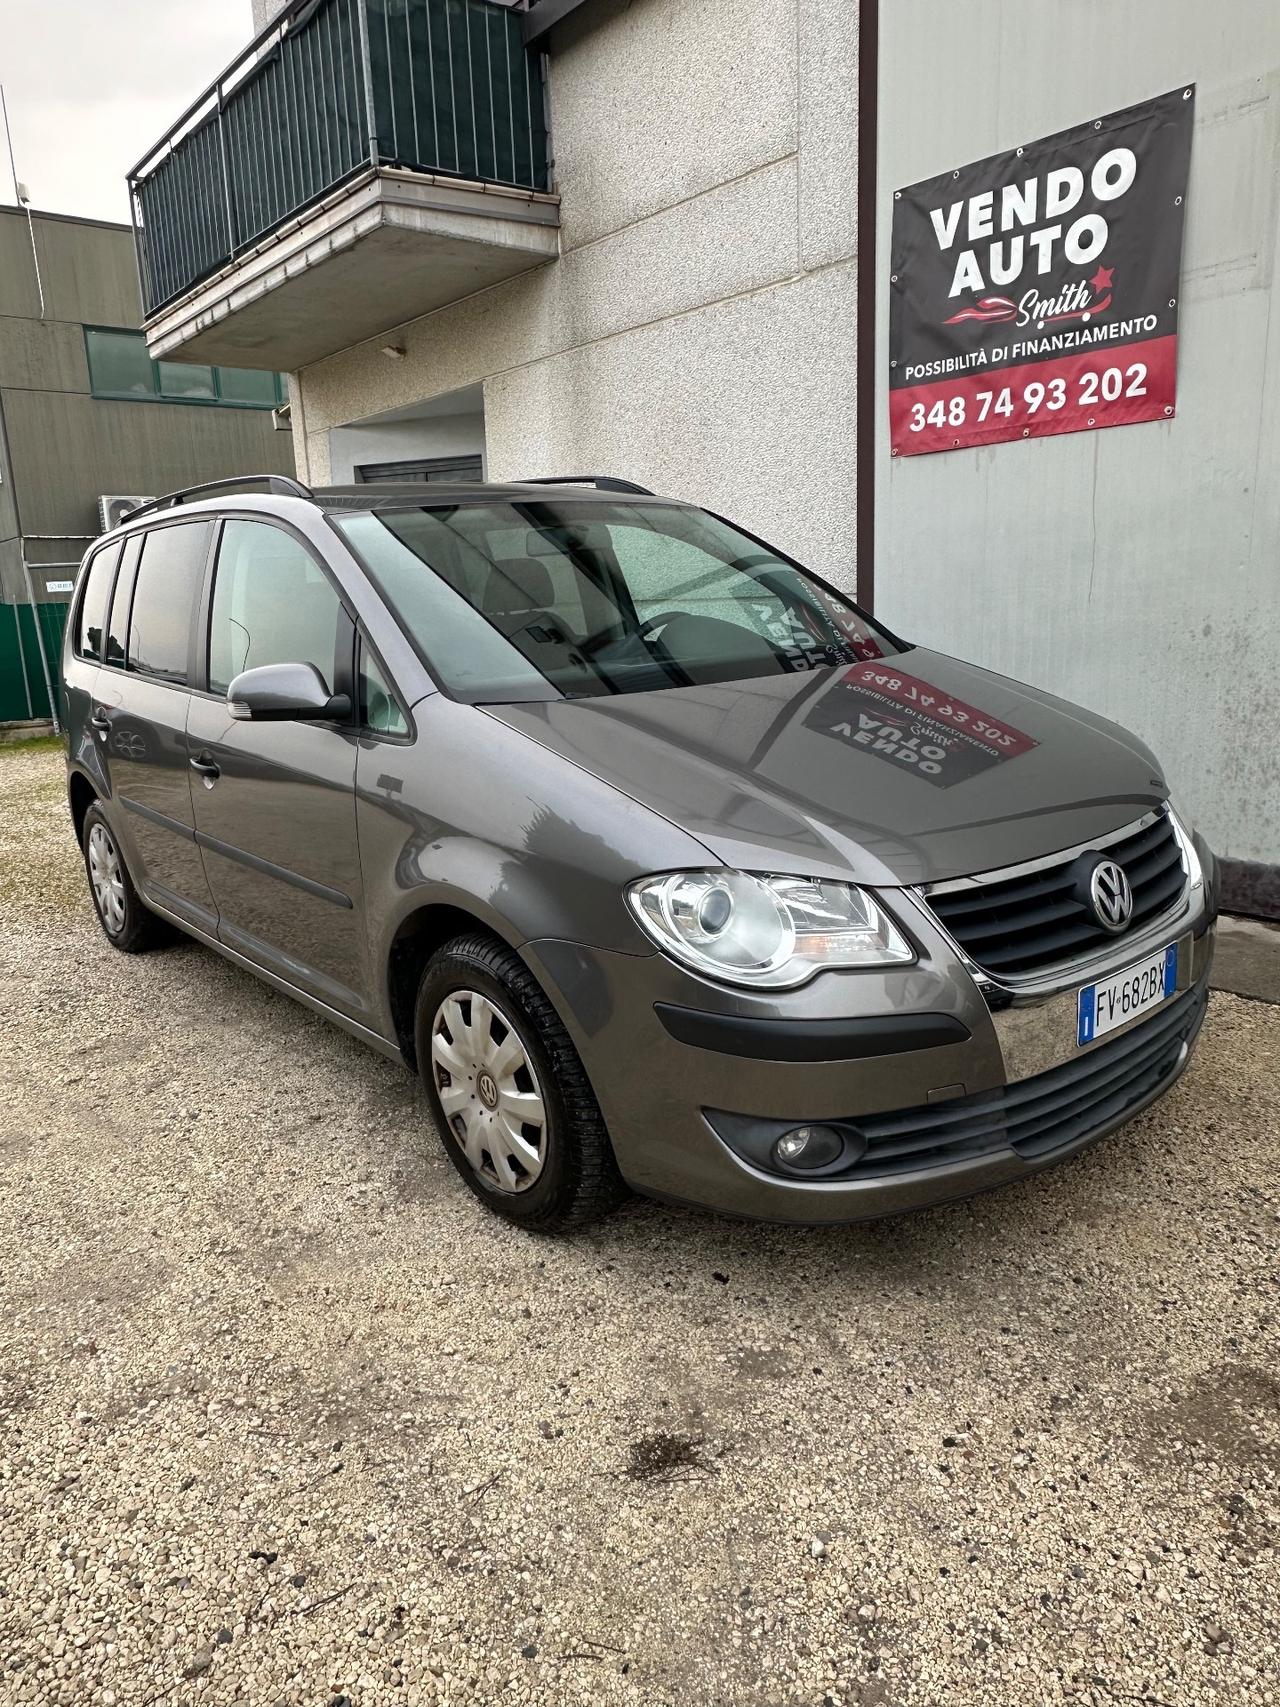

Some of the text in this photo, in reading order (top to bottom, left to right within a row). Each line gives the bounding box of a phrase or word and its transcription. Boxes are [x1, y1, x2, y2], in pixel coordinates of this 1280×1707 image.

[929, 147, 1137, 251] VENDO
[948, 213, 1109, 299] AUTO
[1015, 279, 1093, 328] Smith
[905, 314, 1158, 380] POSSIBILITÀ DI FINANZIAMENTO
[909, 363, 1148, 432] 348 74 93 202
